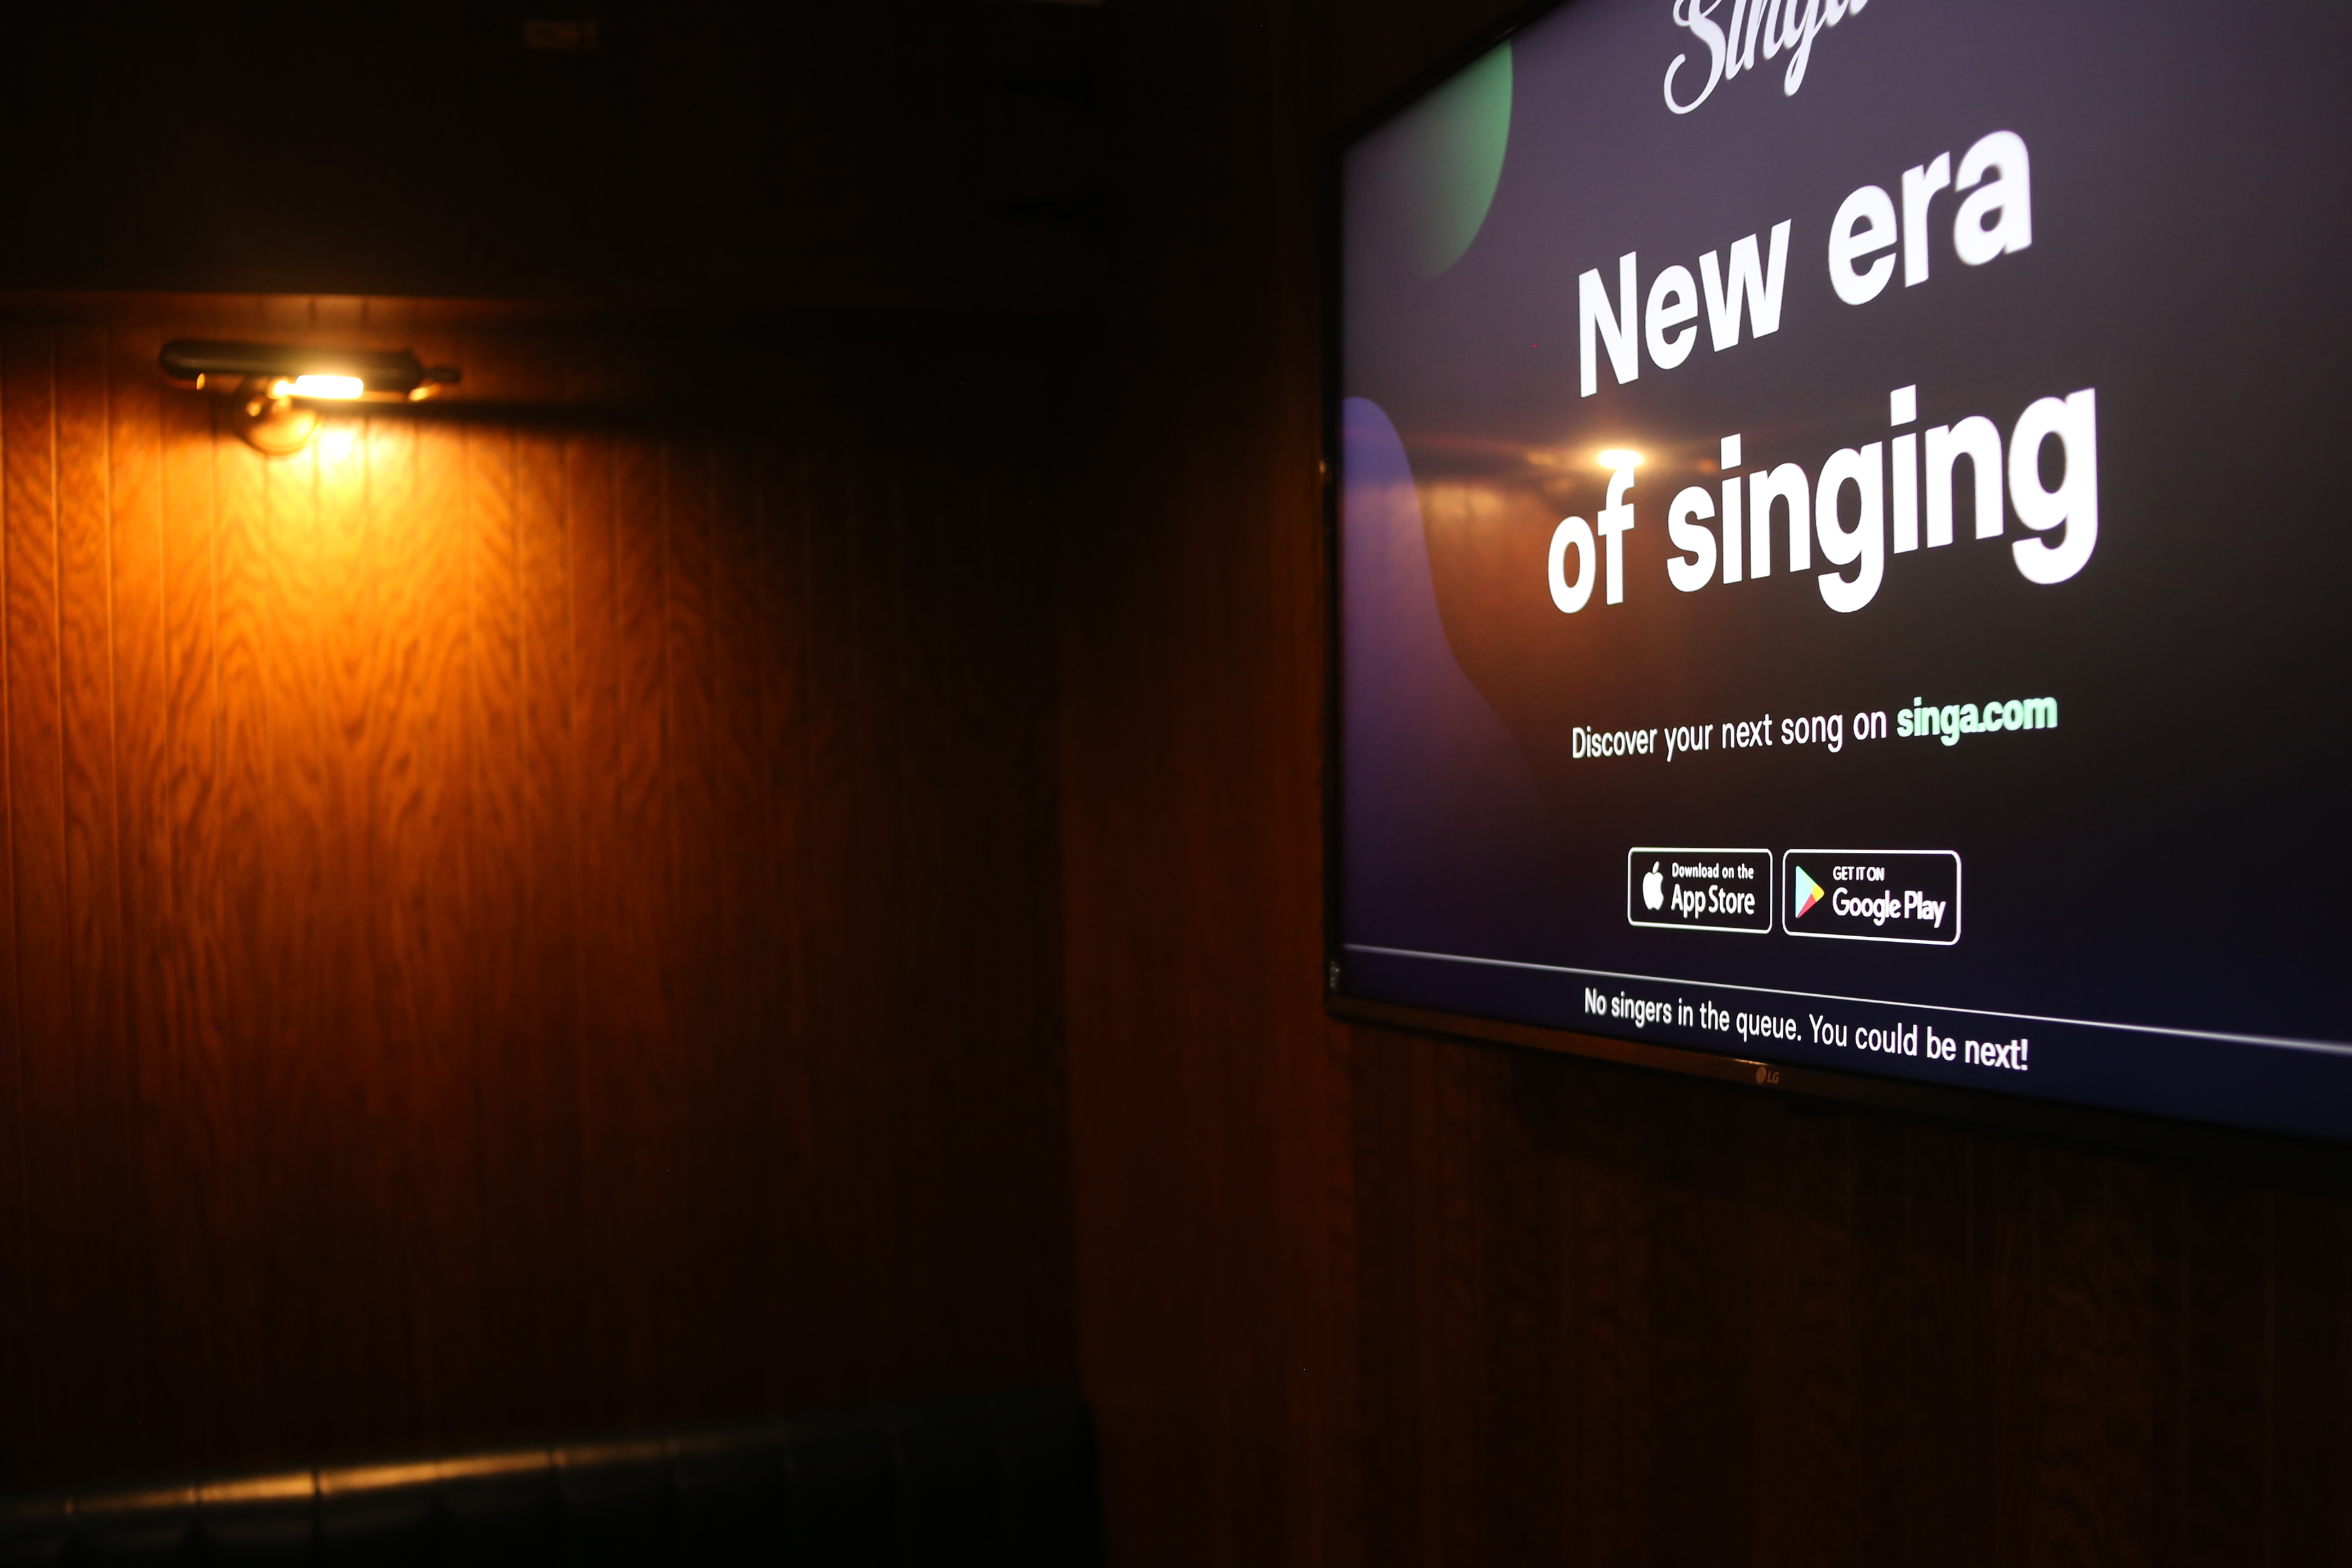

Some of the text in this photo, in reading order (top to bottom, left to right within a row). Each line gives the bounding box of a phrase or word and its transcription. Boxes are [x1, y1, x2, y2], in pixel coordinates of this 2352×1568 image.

[1578, 130, 2032, 398] New era
[1547, 384, 2099, 614] of singing
[1573, 696, 2058, 762] Discover your next song on singa.com
[1672, 862, 1754, 879] Download on the
[1832, 866, 1885, 881] GET IT ON
[1671, 883, 1756, 919] App Store
[1832, 887, 1946, 928] Google Play
[1585, 987, 2028, 1071] No singers in the queue. You could be next!
[1767, 1070, 1779, 1084] LG
